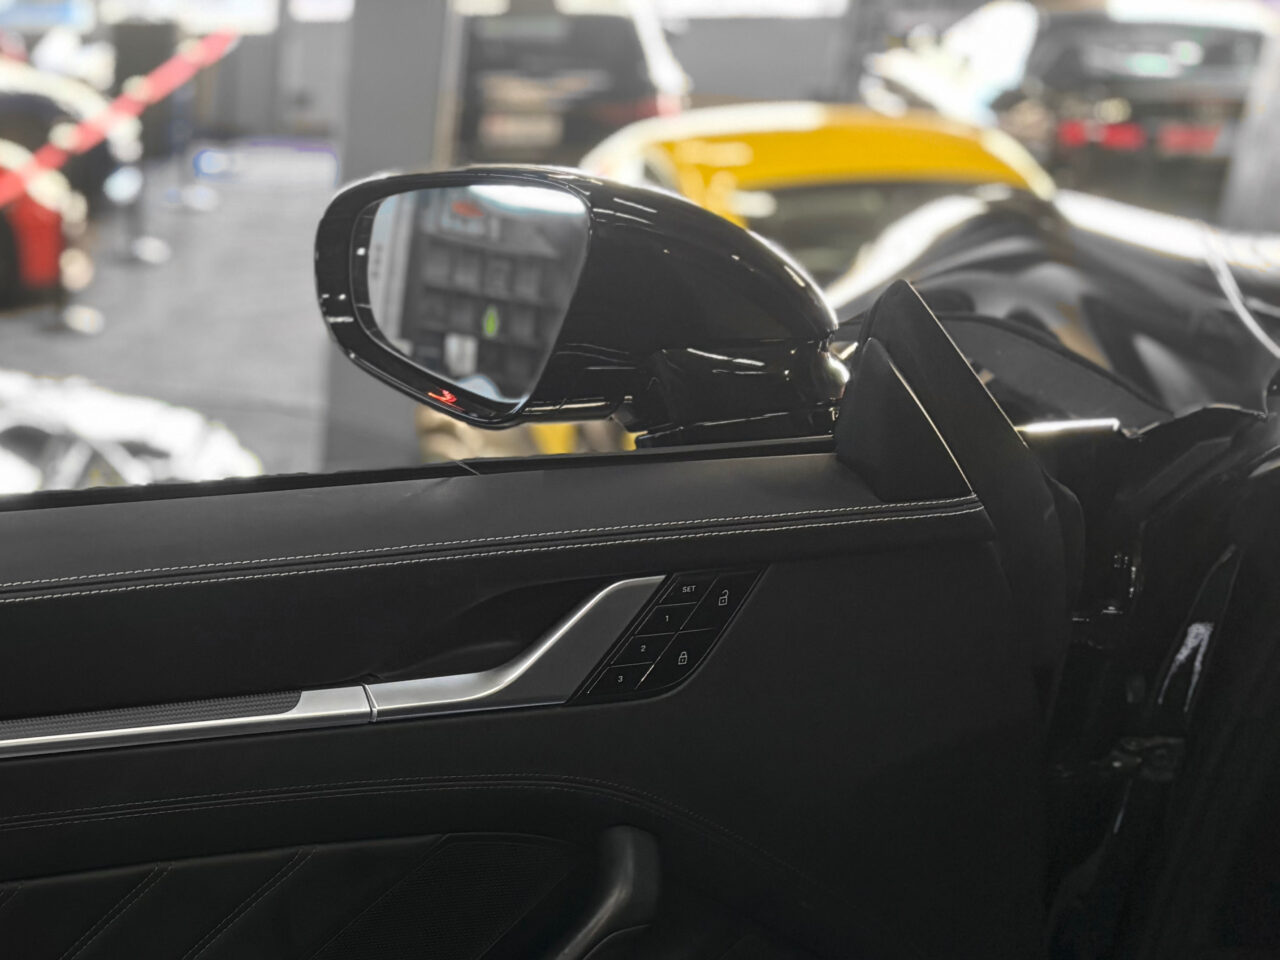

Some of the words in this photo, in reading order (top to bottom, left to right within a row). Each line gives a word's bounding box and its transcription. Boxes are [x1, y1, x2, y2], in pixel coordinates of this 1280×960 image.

[682, 585, 696, 593] SET
[640, 644, 646, 652] 2
[617, 675, 624, 683] 3
